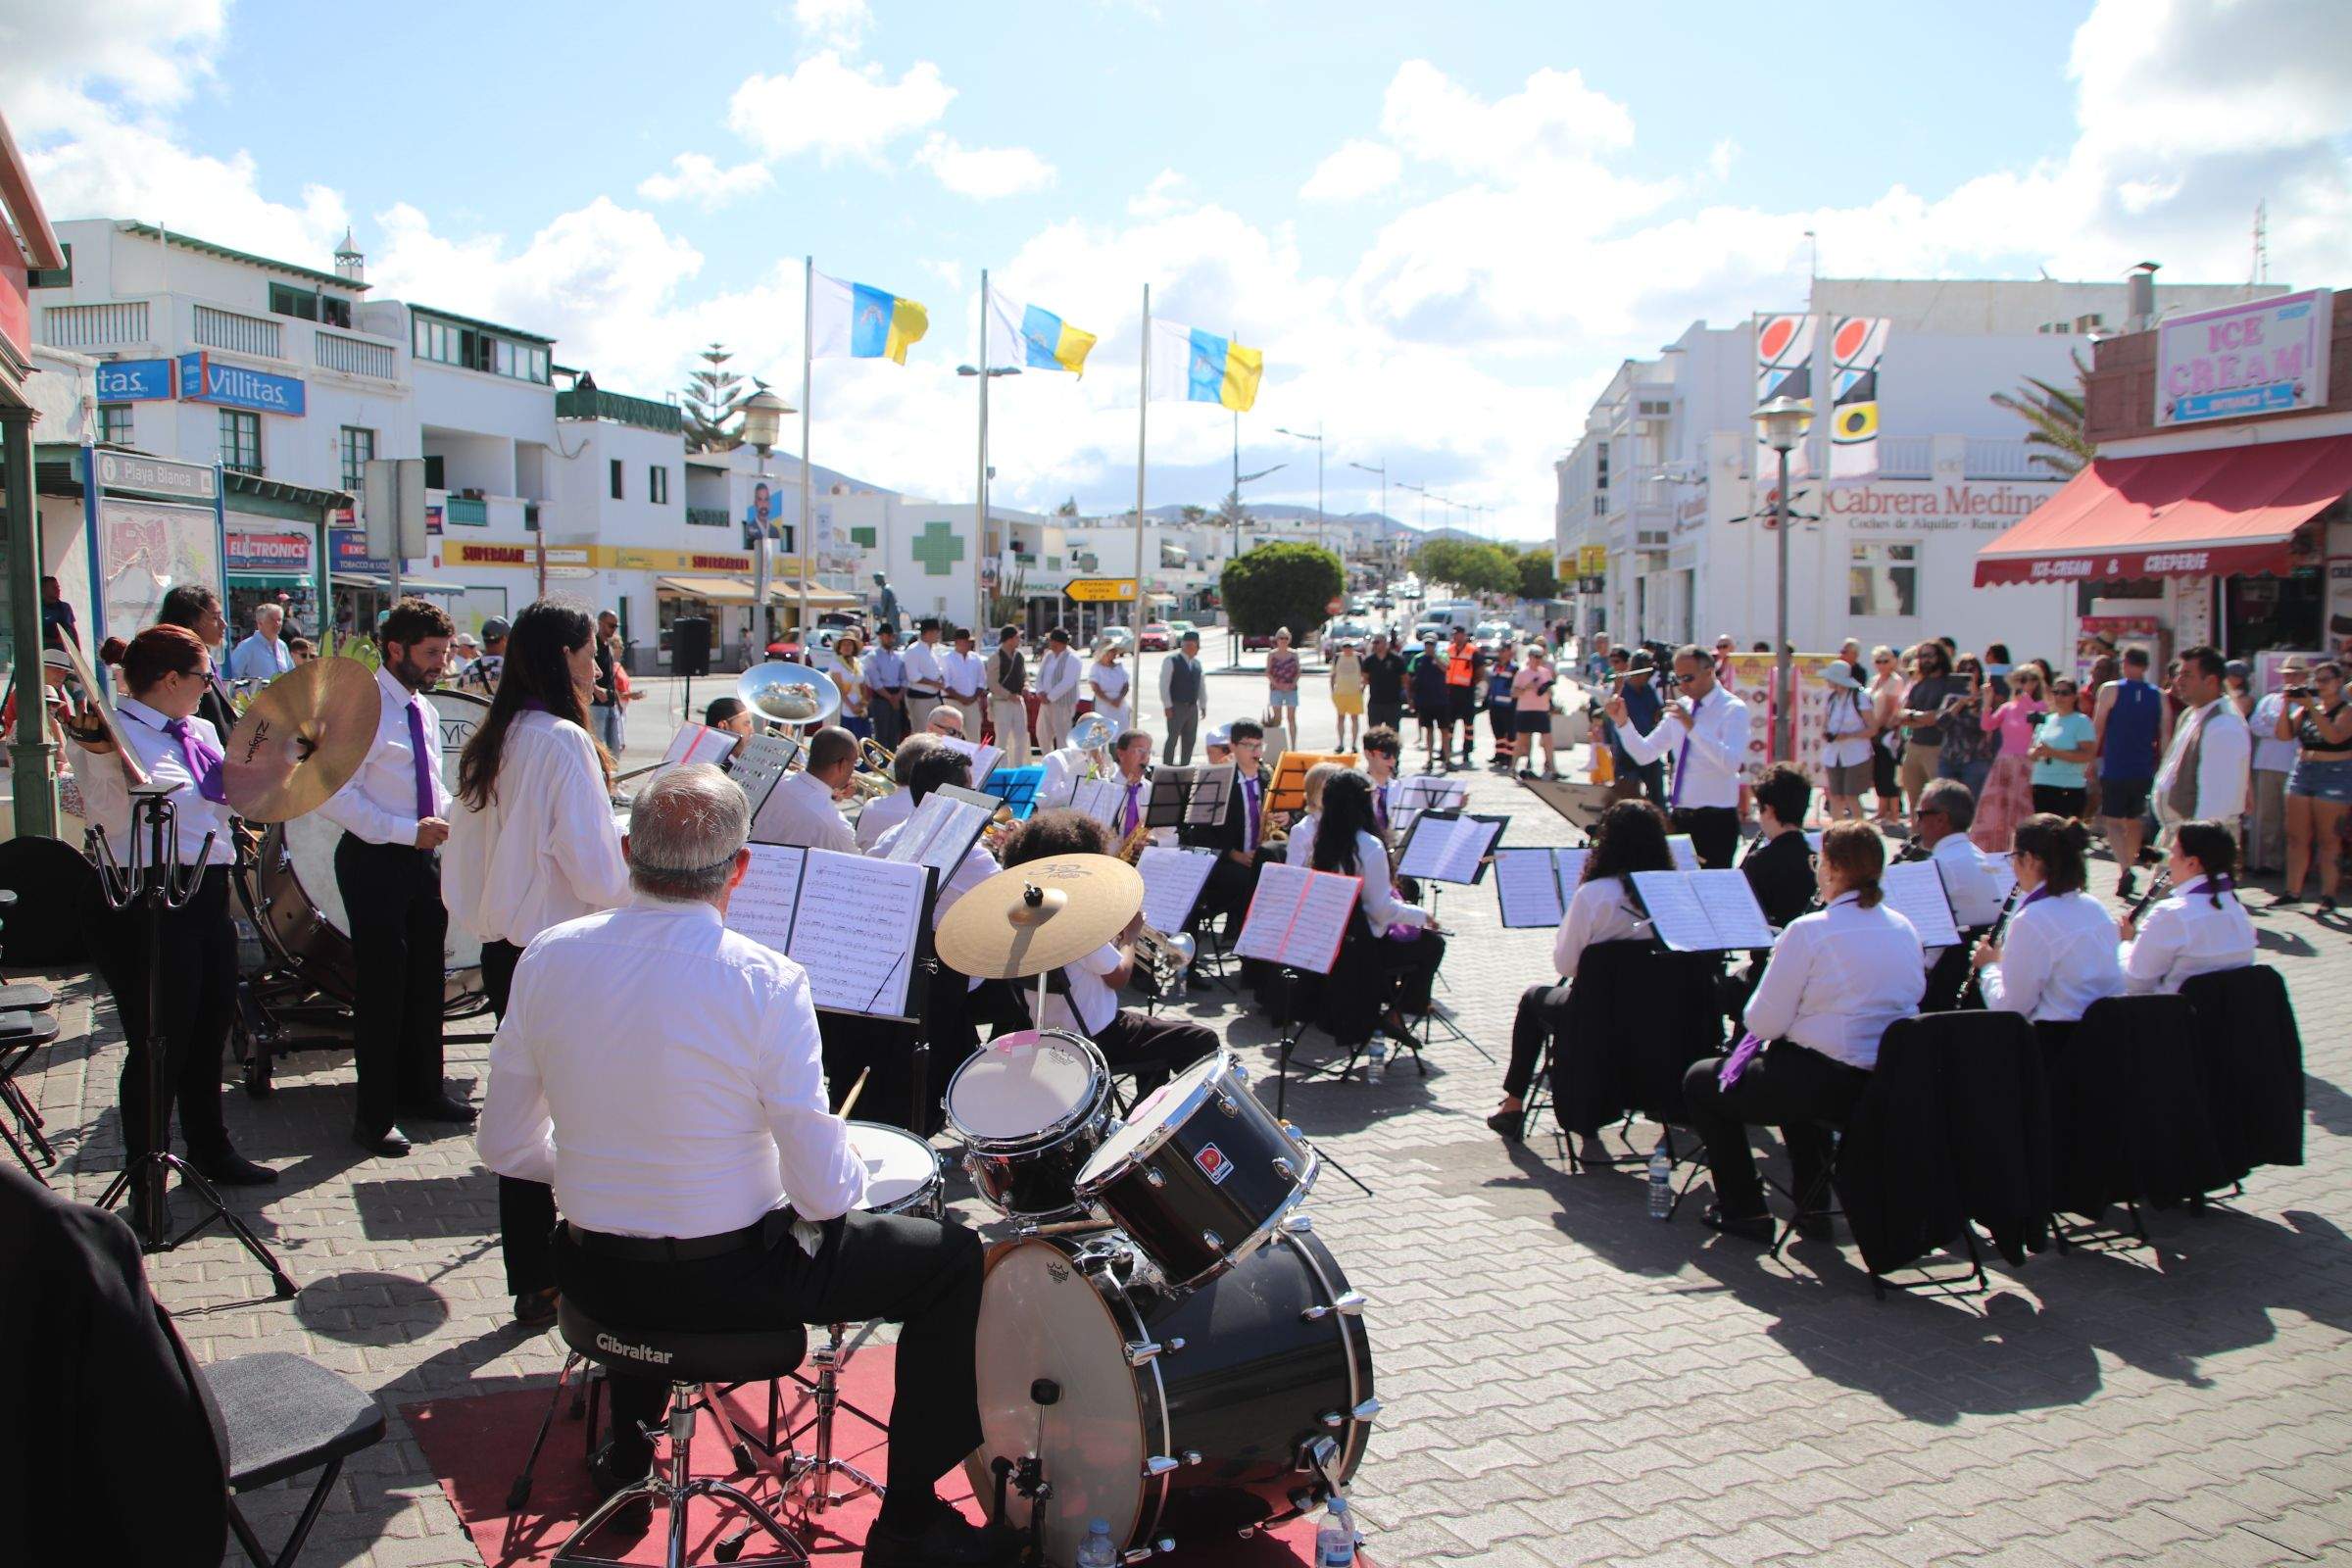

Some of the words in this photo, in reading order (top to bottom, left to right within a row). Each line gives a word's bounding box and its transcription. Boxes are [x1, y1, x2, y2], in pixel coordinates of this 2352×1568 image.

[2208, 317, 2265, 353] ICE
[2168, 343, 2305, 397] CREAM
[208, 368, 284, 404] Villitas
[123, 461, 154, 485] Playa
[157, 466, 191, 487] Blanca
[1828, 486, 1938, 514] Cabrera
[1944, 486, 2049, 514] Medina
[1849, 517, 1888, 529] Coches
[1894, 517, 1908, 529] de
[1912, 517, 1959, 531] Alquiler
[1972, 517, 1997, 529] Rent
[2106, 558, 2119, 575] &
[245, 719, 270, 764] Zildjian
[596, 1333, 673, 1364] Gibraltar
